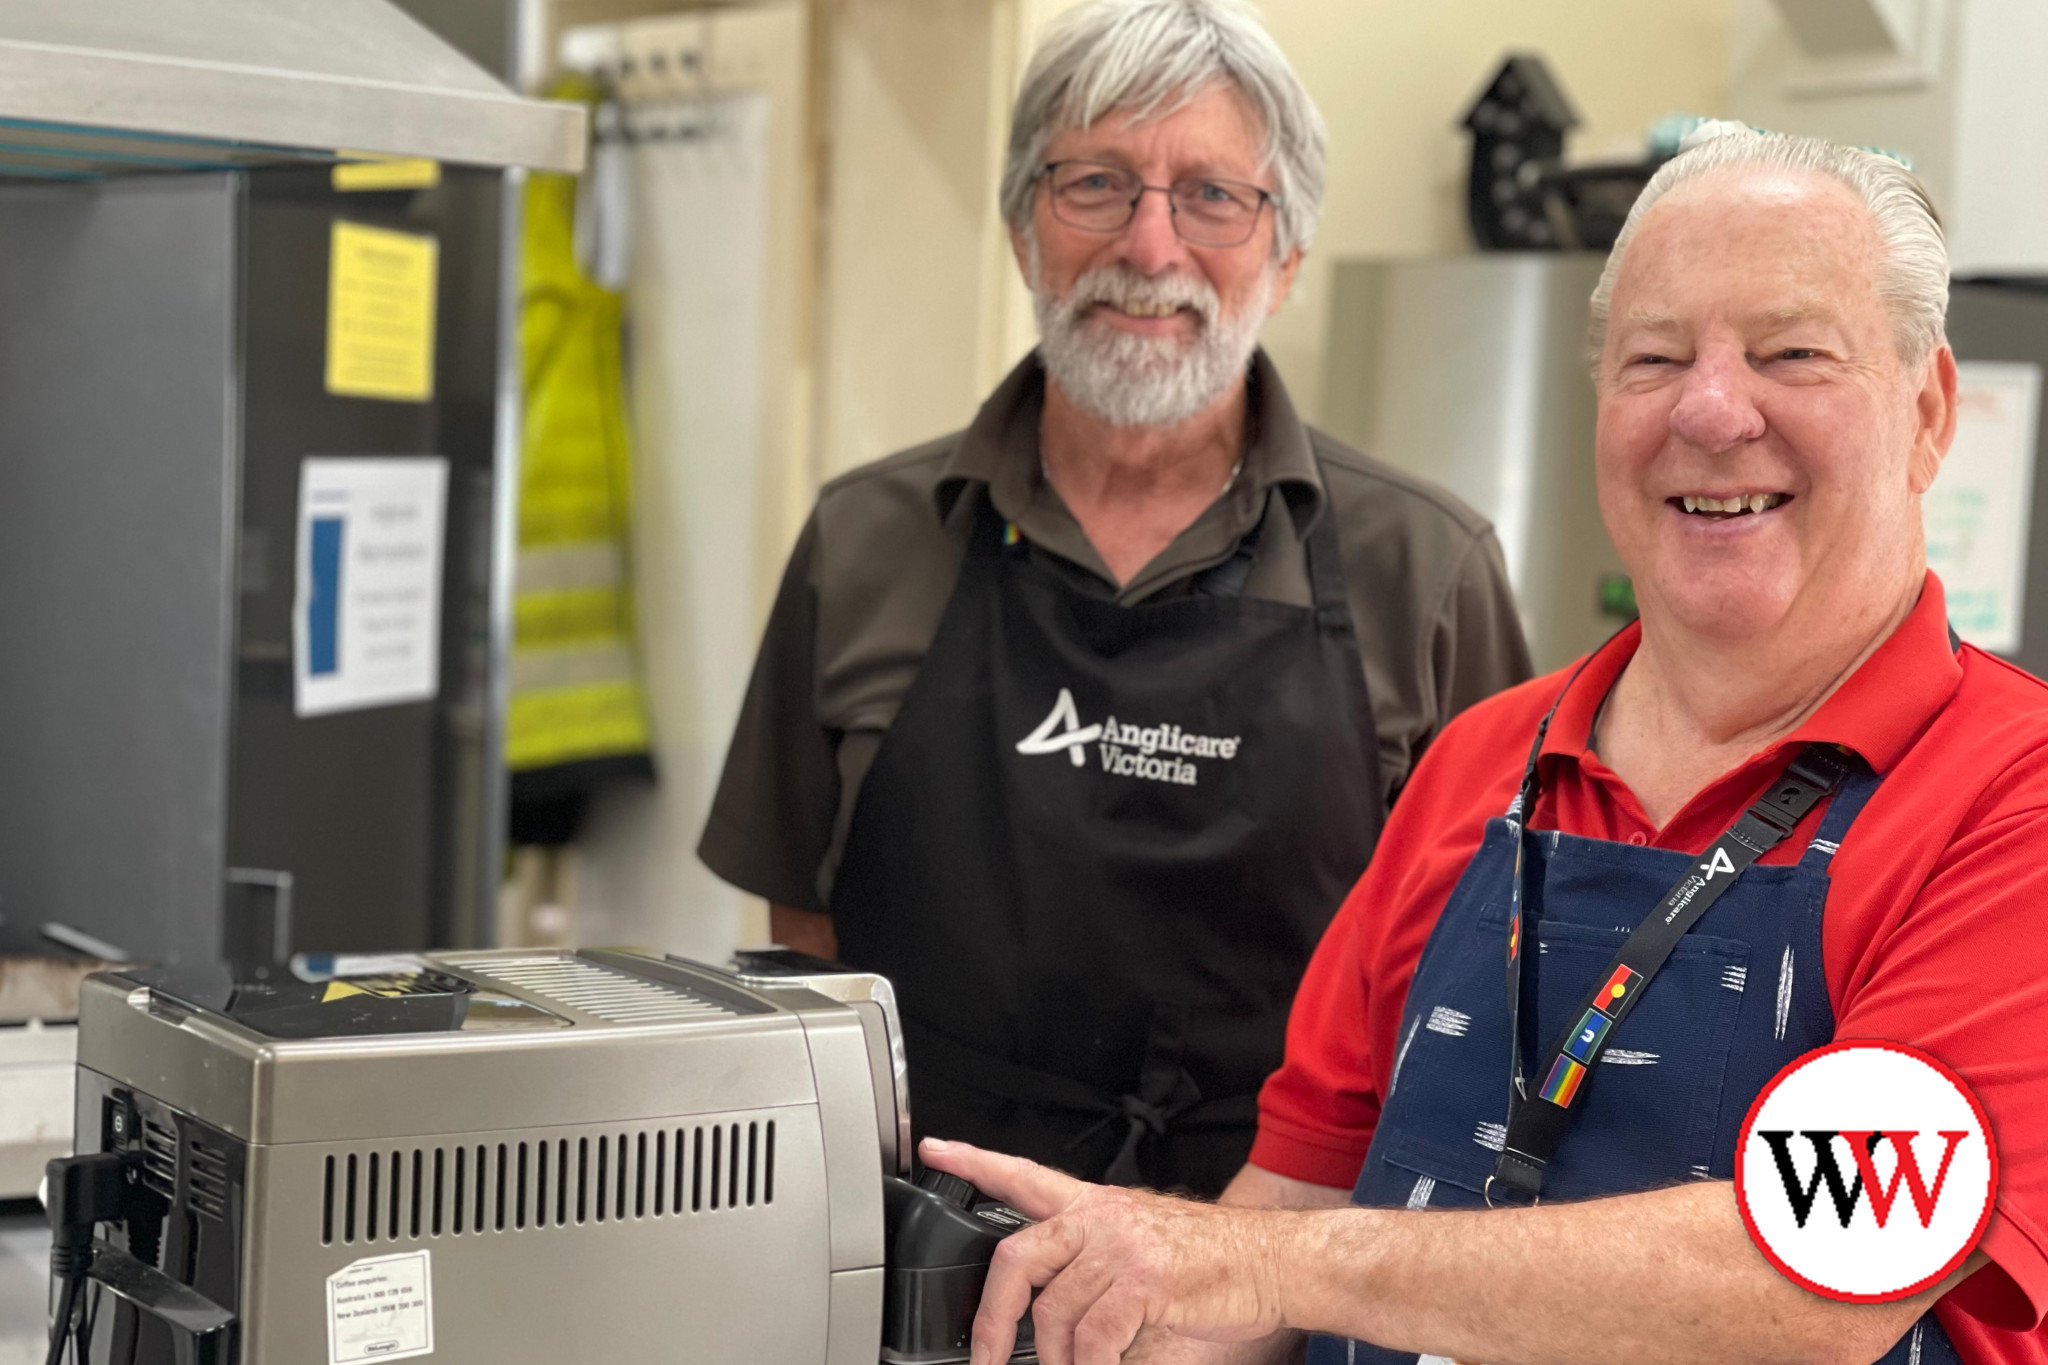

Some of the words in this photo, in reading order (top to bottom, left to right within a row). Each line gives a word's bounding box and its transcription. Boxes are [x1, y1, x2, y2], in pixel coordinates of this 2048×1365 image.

[1101, 715, 1237, 760] Anglicare
[1099, 743, 1198, 786] Victoria
[1665, 877, 1706, 923] Anglicare
[1668, 875, 1700, 906] Victoria
